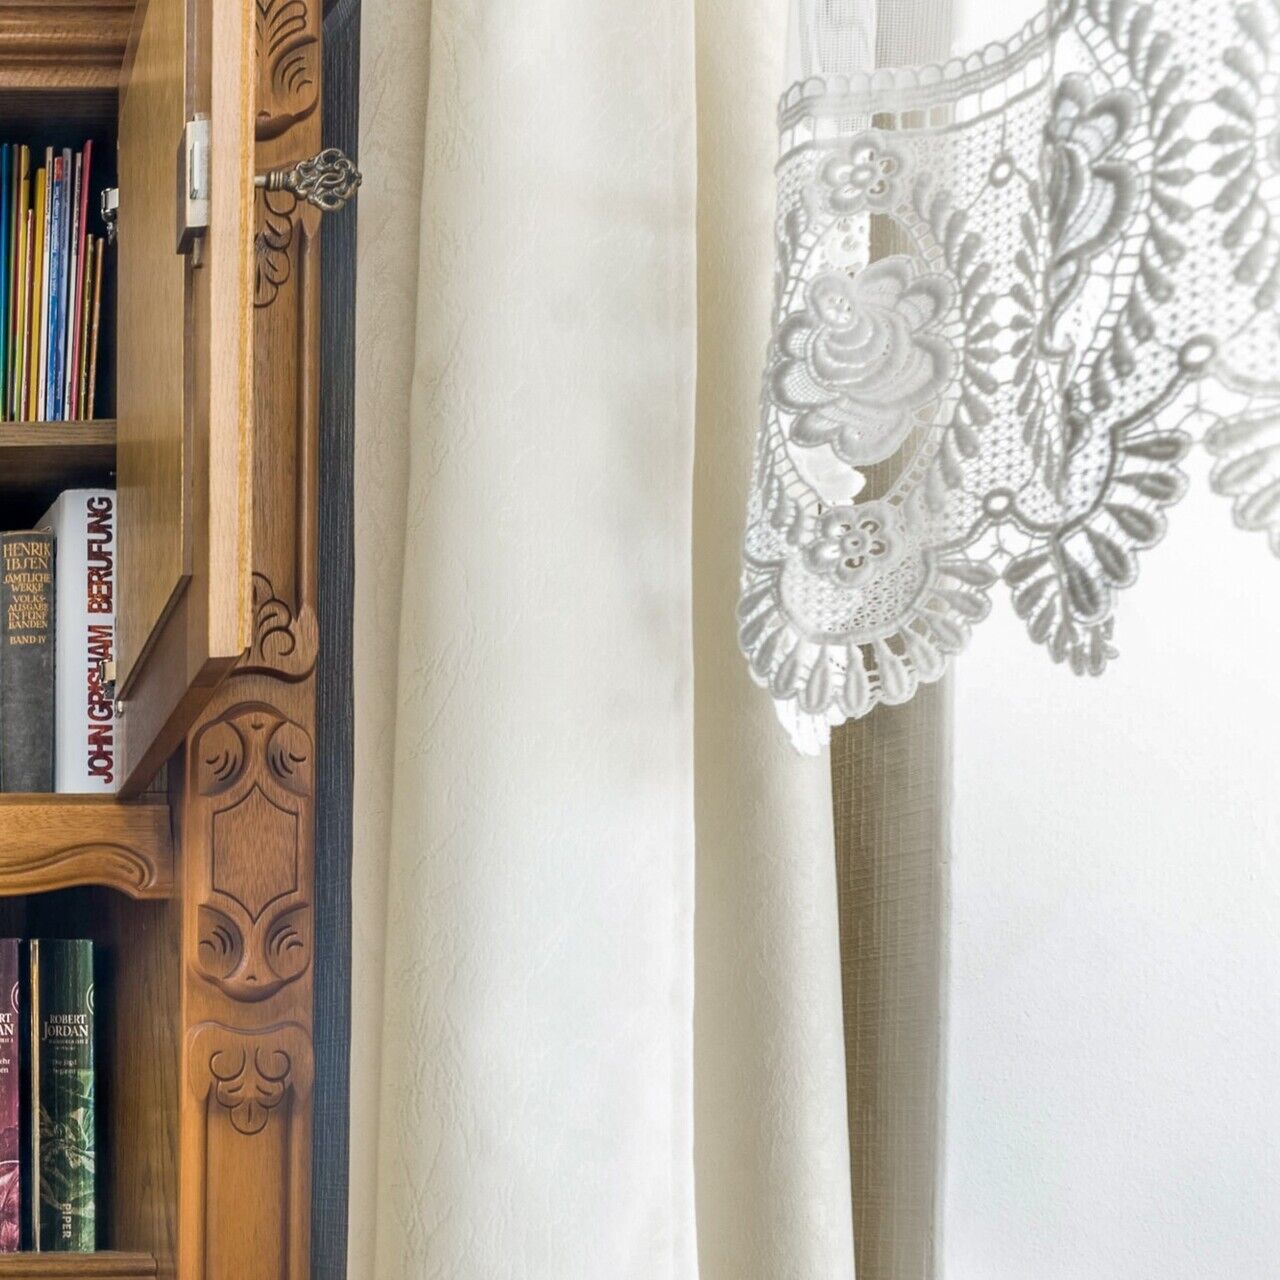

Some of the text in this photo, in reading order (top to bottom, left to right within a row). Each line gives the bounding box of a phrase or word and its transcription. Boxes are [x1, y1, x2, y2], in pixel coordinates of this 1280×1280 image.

[3, 542, 51, 558] HENRIK
[87, 497, 113, 614] BERUFUNG
[88, 725, 114, 784] JOHN
